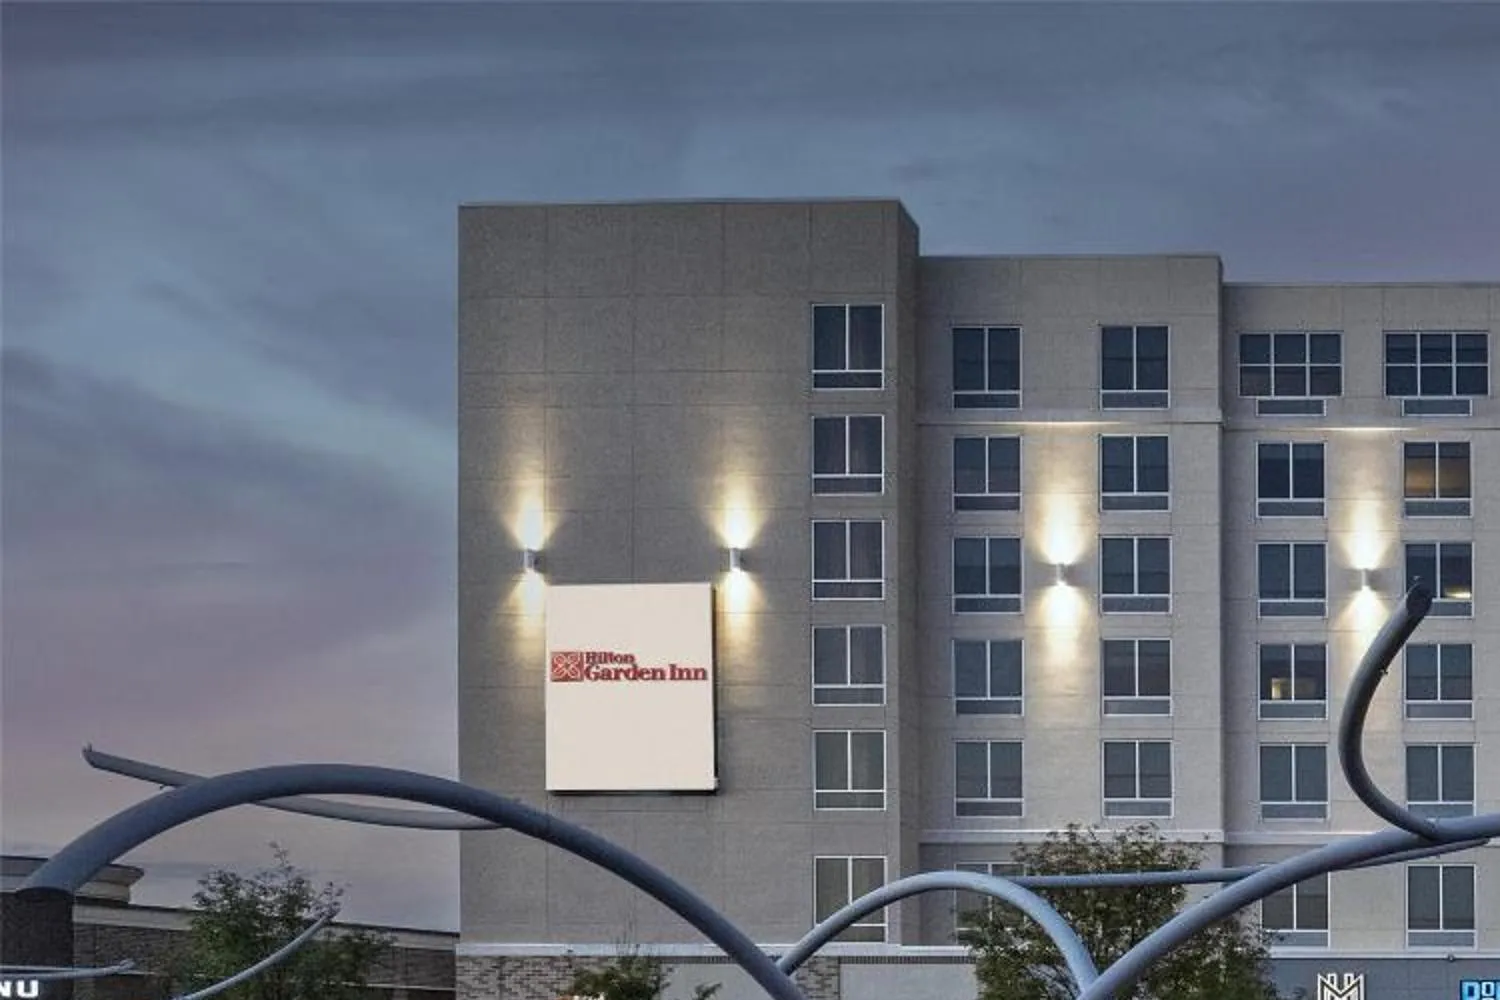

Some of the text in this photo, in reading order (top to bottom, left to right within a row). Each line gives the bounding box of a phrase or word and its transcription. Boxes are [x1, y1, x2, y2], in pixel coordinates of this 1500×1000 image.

[585, 651, 635, 665] Hilton
[585, 663, 708, 682] Garden Inn
